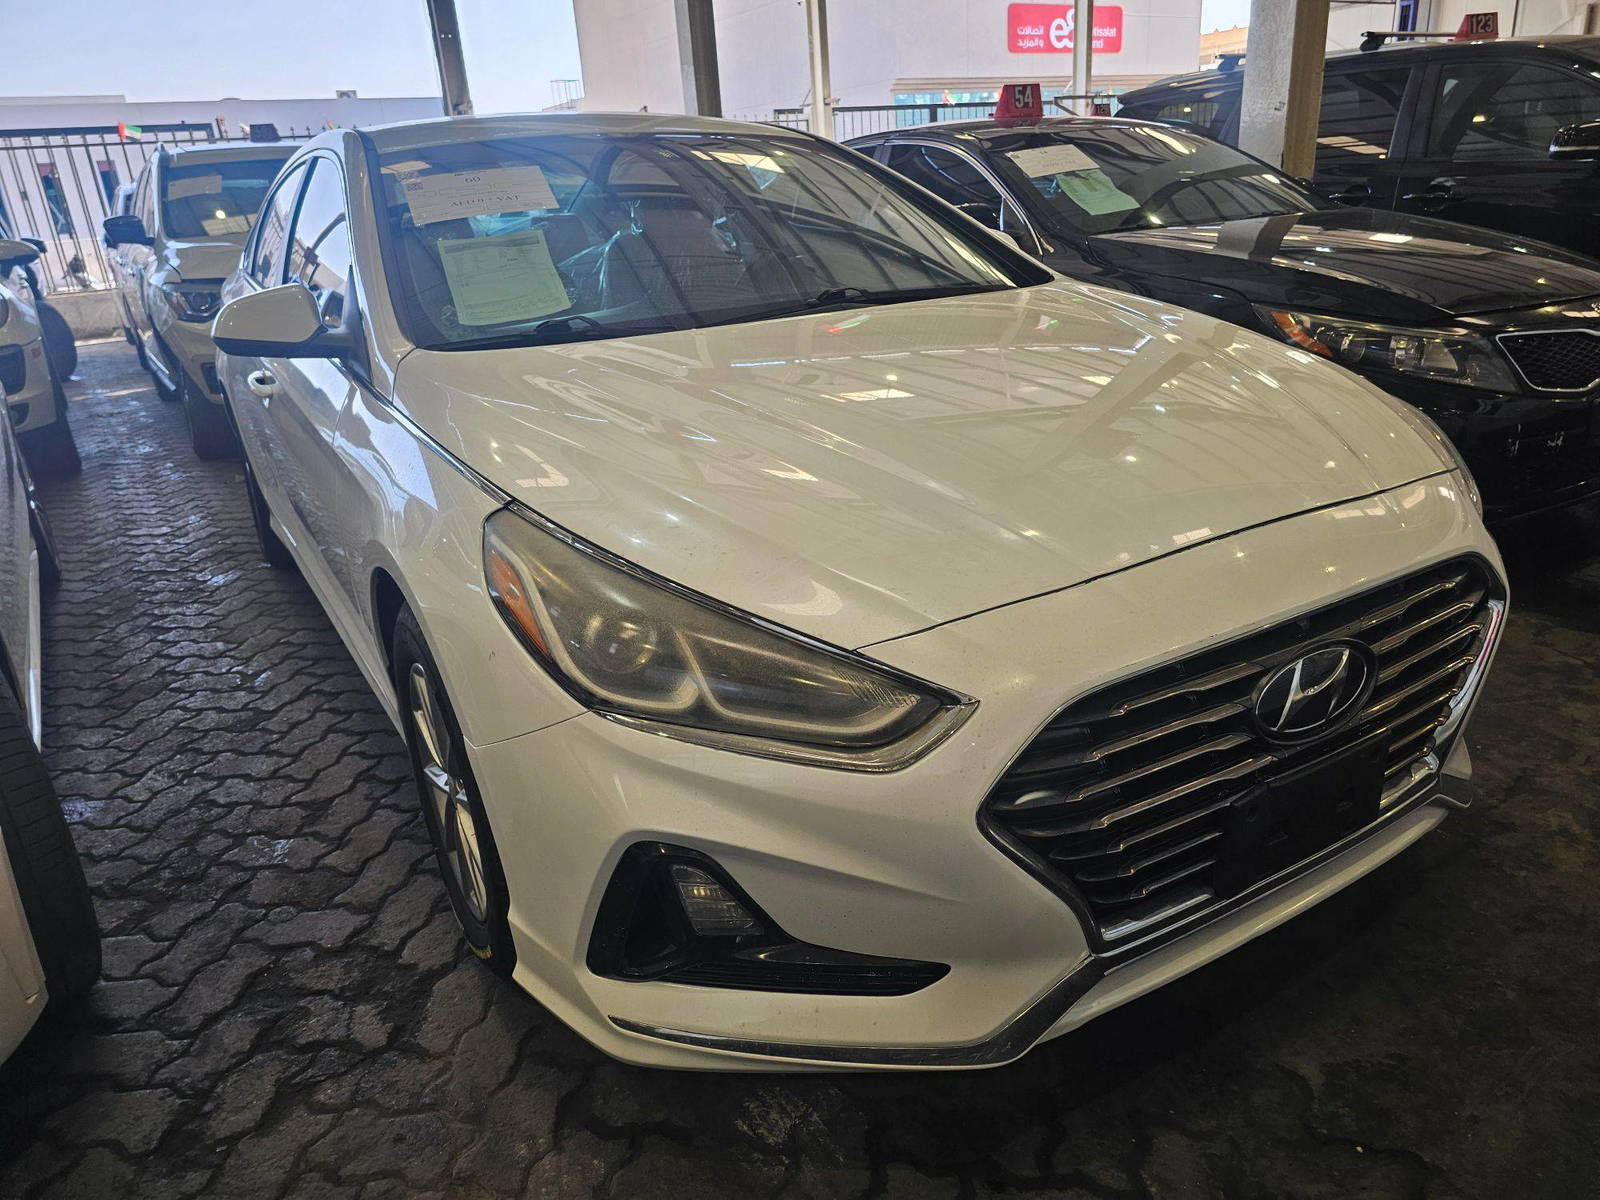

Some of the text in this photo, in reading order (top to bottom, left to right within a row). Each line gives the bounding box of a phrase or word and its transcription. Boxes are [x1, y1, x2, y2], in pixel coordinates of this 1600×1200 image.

[1017, 24, 1044, 35] اتصالات
[1472, 14, 1493, 33] 123
[1092, 25, 1117, 37] tisalat
[1017, 37, 1044, 49] والمزيد
[1092, 38, 1104, 49] nd
[1014, 85, 1033, 109] 54
